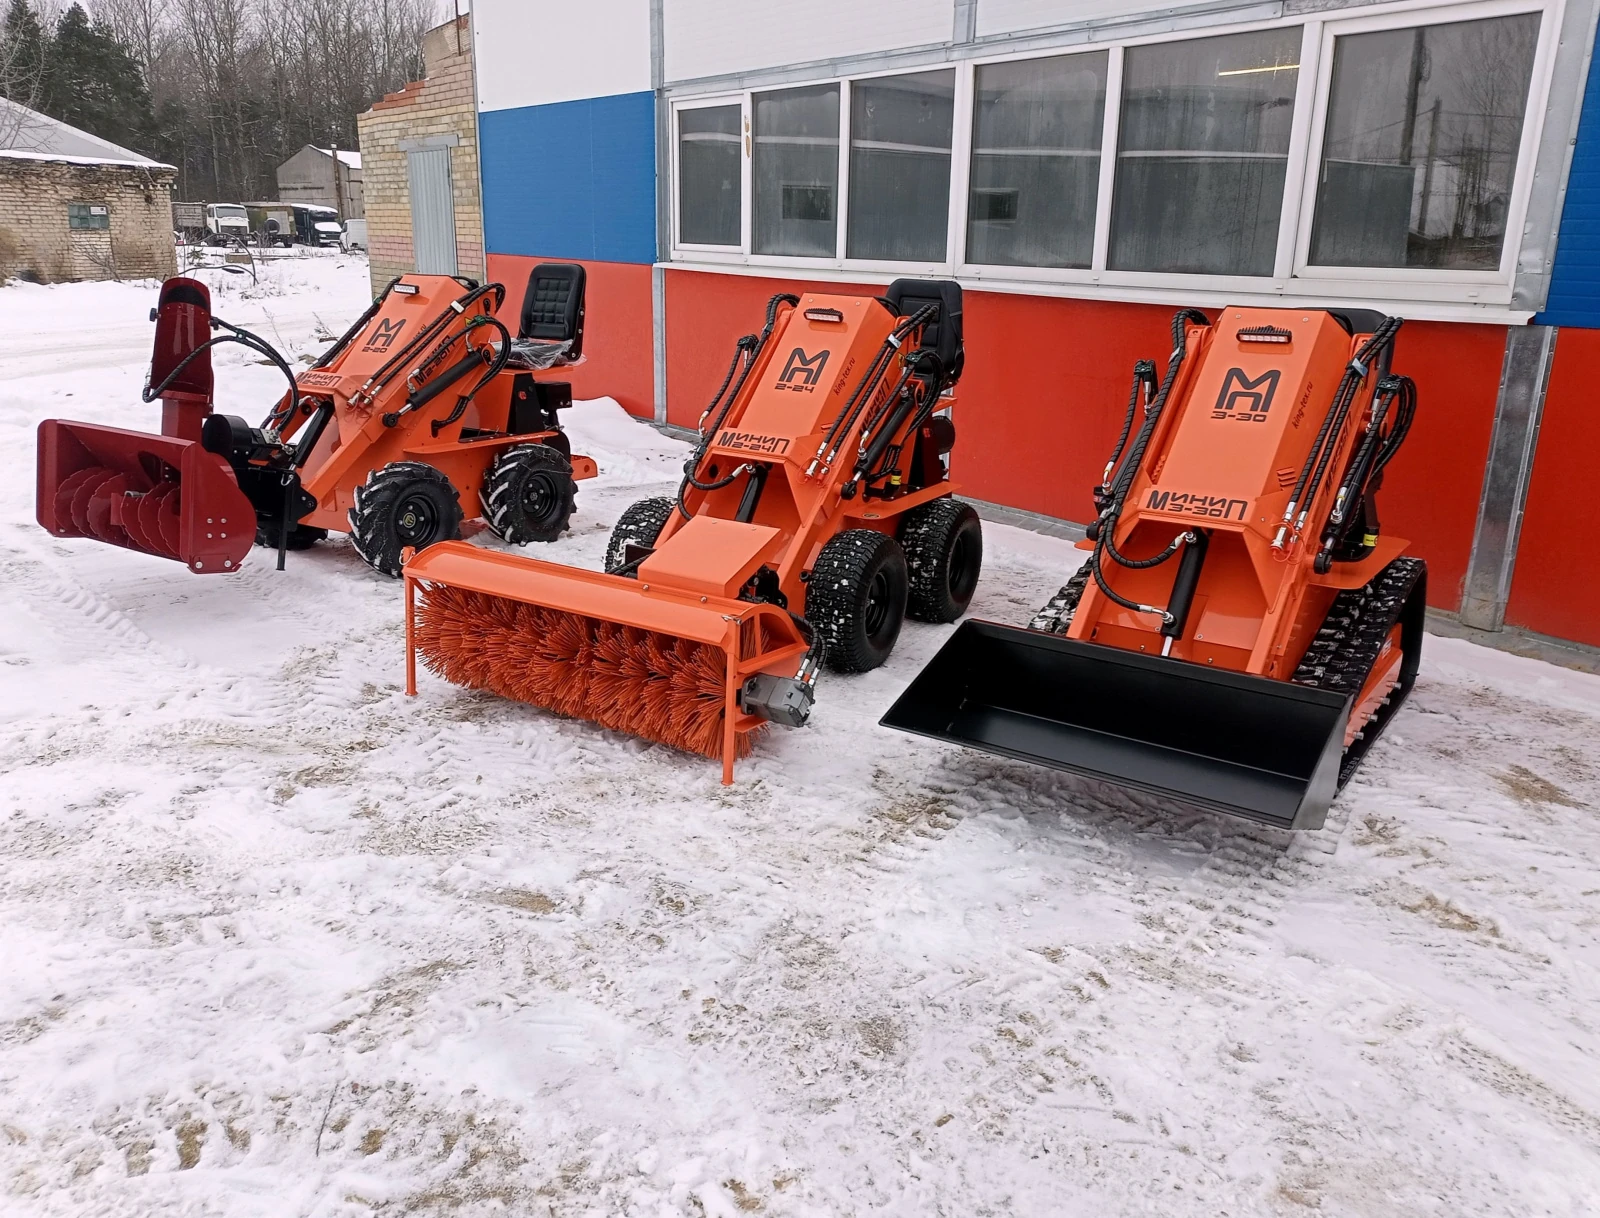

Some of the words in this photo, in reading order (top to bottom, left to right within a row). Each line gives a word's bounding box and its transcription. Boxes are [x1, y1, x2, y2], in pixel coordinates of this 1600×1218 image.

[361, 346, 388, 354] 2-20
[296, 371, 343, 388] МИНИП
[302, 379, 328, 387] 2-20
[833, 357, 856, 396] king-tex.ru
[774, 382, 815, 394] 2-24
[1291, 381, 1314, 430] king-tex.ru
[1210, 410, 1267, 423] 3-30
[717, 431, 791, 454] МИНИП
[731, 441, 772, 453] 2-24
[1145, 490, 1248, 521] МИНИП
[1168, 503, 1223, 517] 3-30
